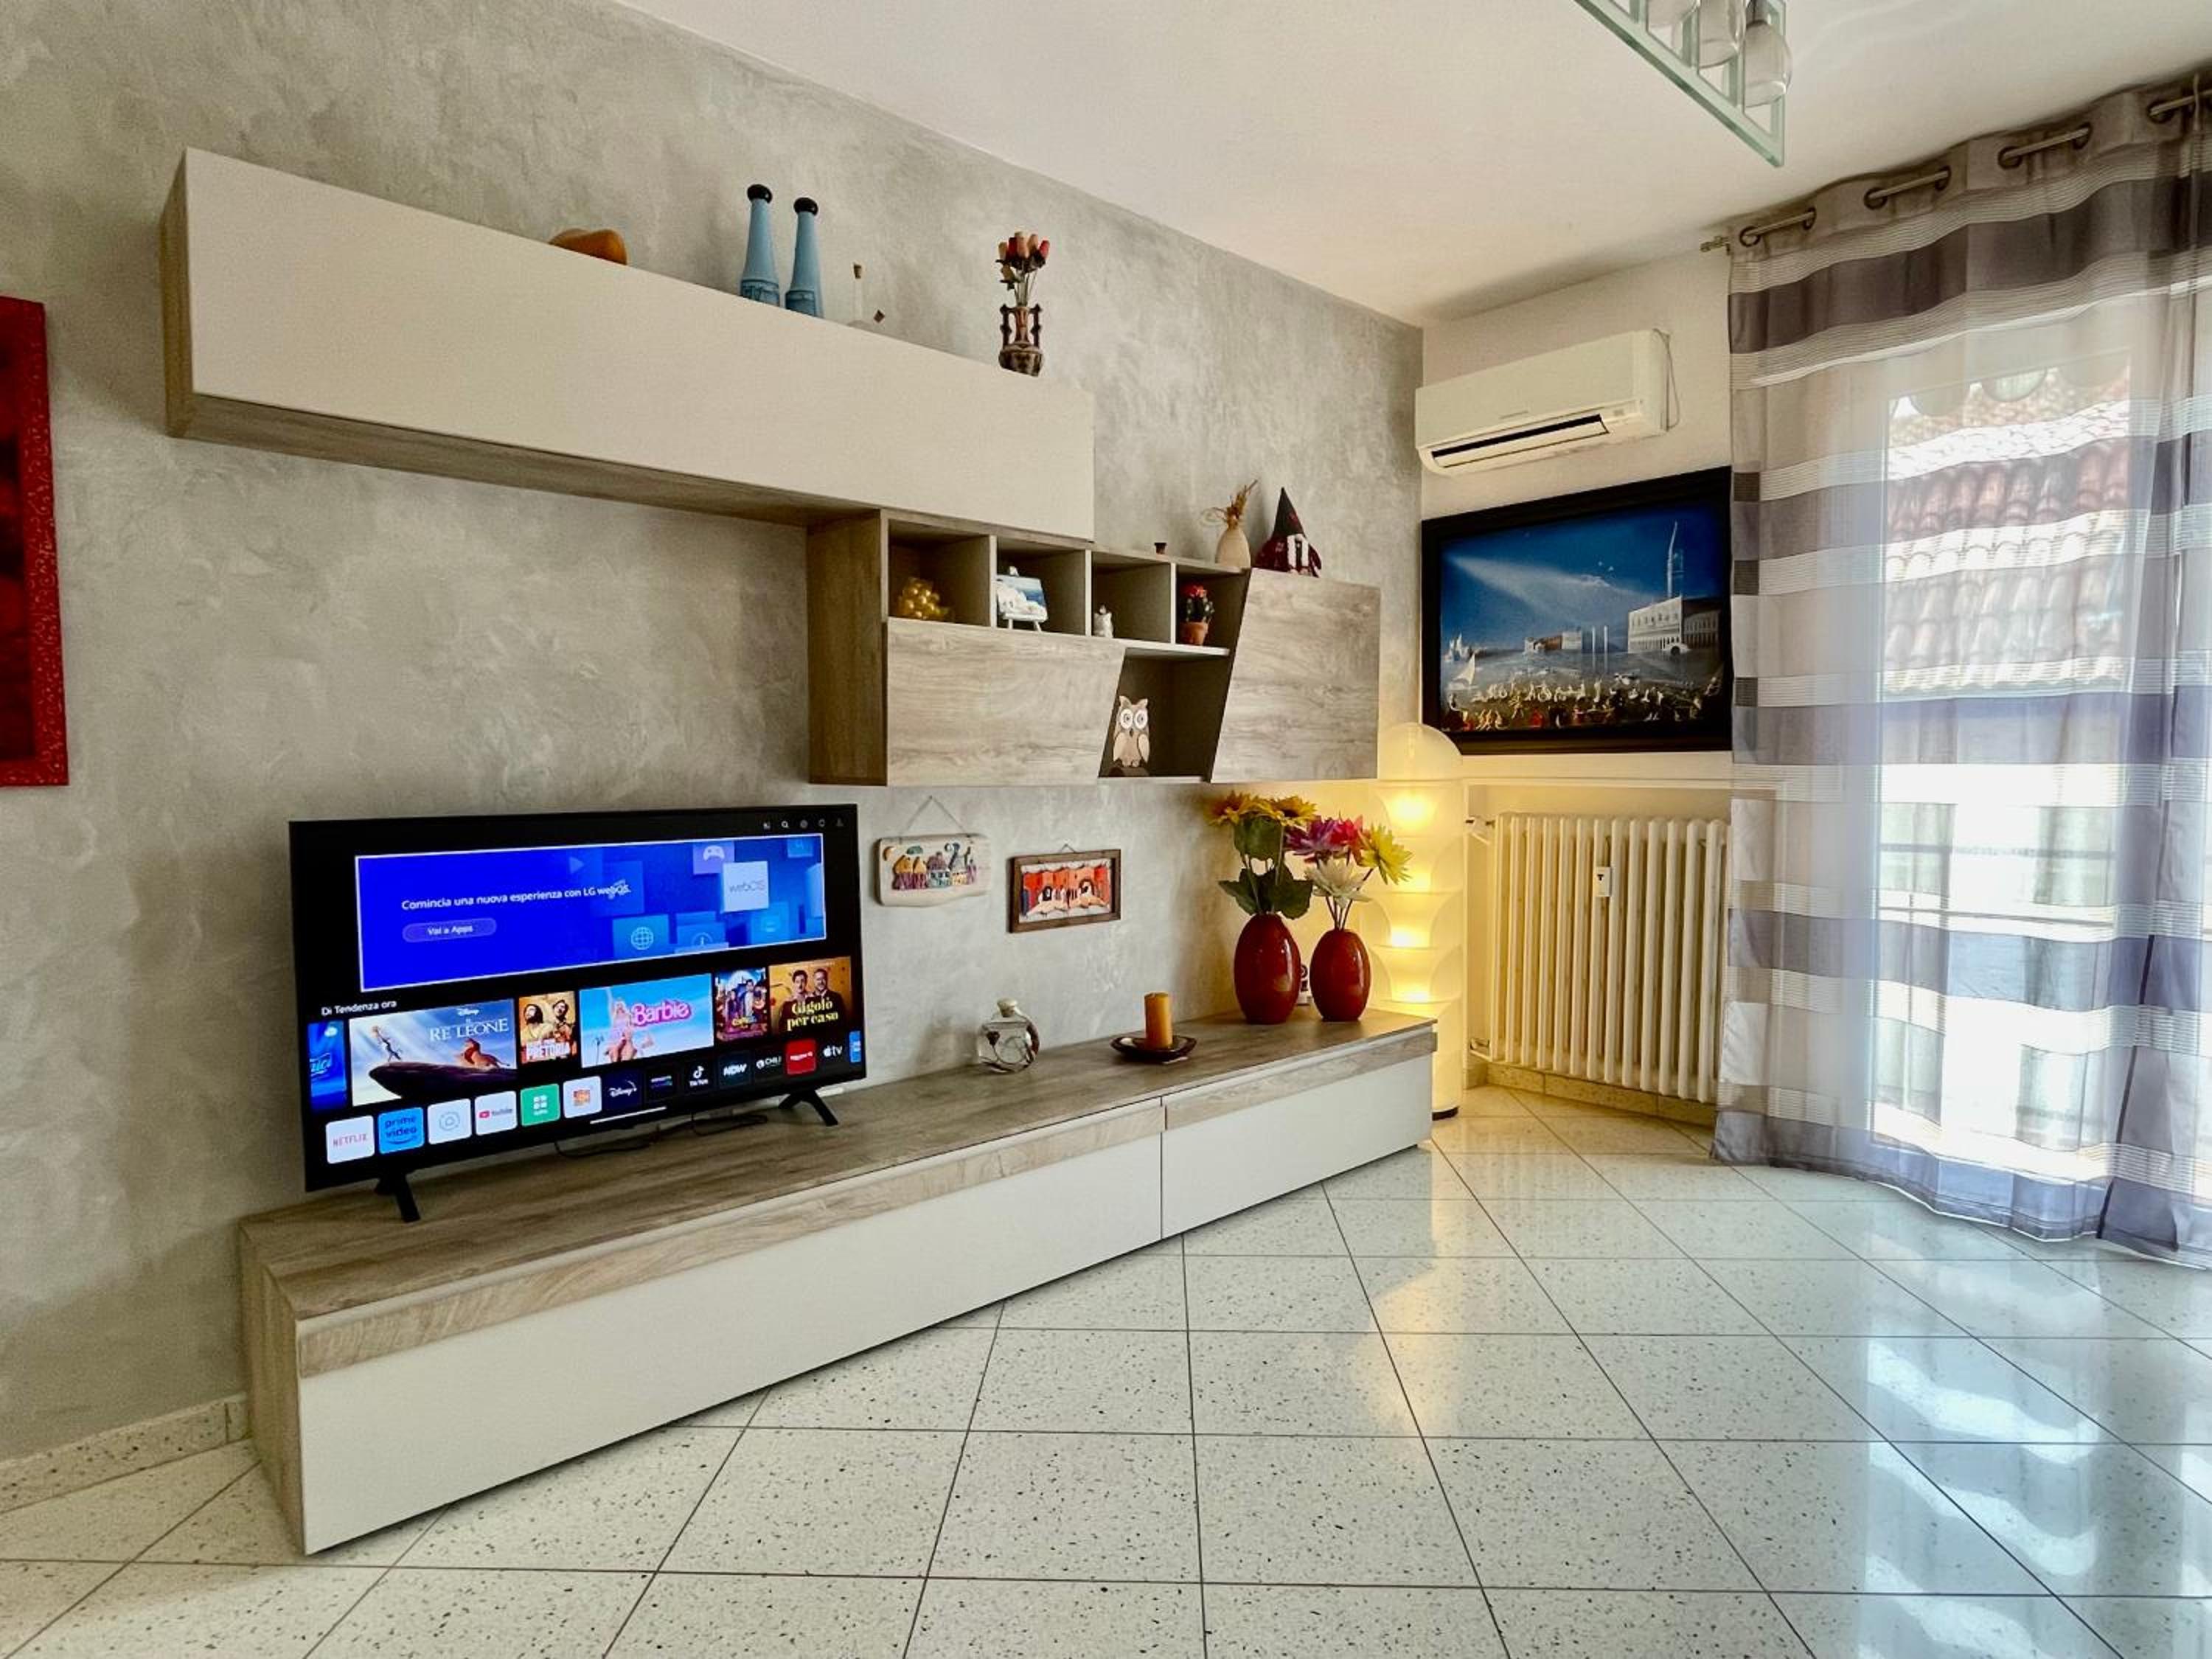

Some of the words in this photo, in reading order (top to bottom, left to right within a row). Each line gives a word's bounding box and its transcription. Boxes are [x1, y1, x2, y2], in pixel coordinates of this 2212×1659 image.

[401, 897, 452, 911] Comincia
[454, 896, 474, 906] una
[476, 894, 508, 905] nuova
[509, 889, 563, 903] esperienza
[564, 888, 581, 898] con
[583, 887, 596, 897] LG
[427, 927, 442, 936] Vai
[451, 925, 473, 936] Apps
[321, 1006, 333, 1016] Di
[335, 1003, 380, 1015] Tendenza
[381, 1000, 397, 1009] ora
[632, 1000, 691, 1026] Barbie
[791, 996, 834, 1015] Gigolò
[430, 1026, 452, 1042] RE
[456, 1018, 510, 1039] LEONE
[786, 1016, 810, 1032] per
[810, 1011, 839, 1026] caso
[384, 1115, 417, 1129] prime
[333, 1133, 368, 1147] NETFLIX
[385, 1126, 418, 1138] video
